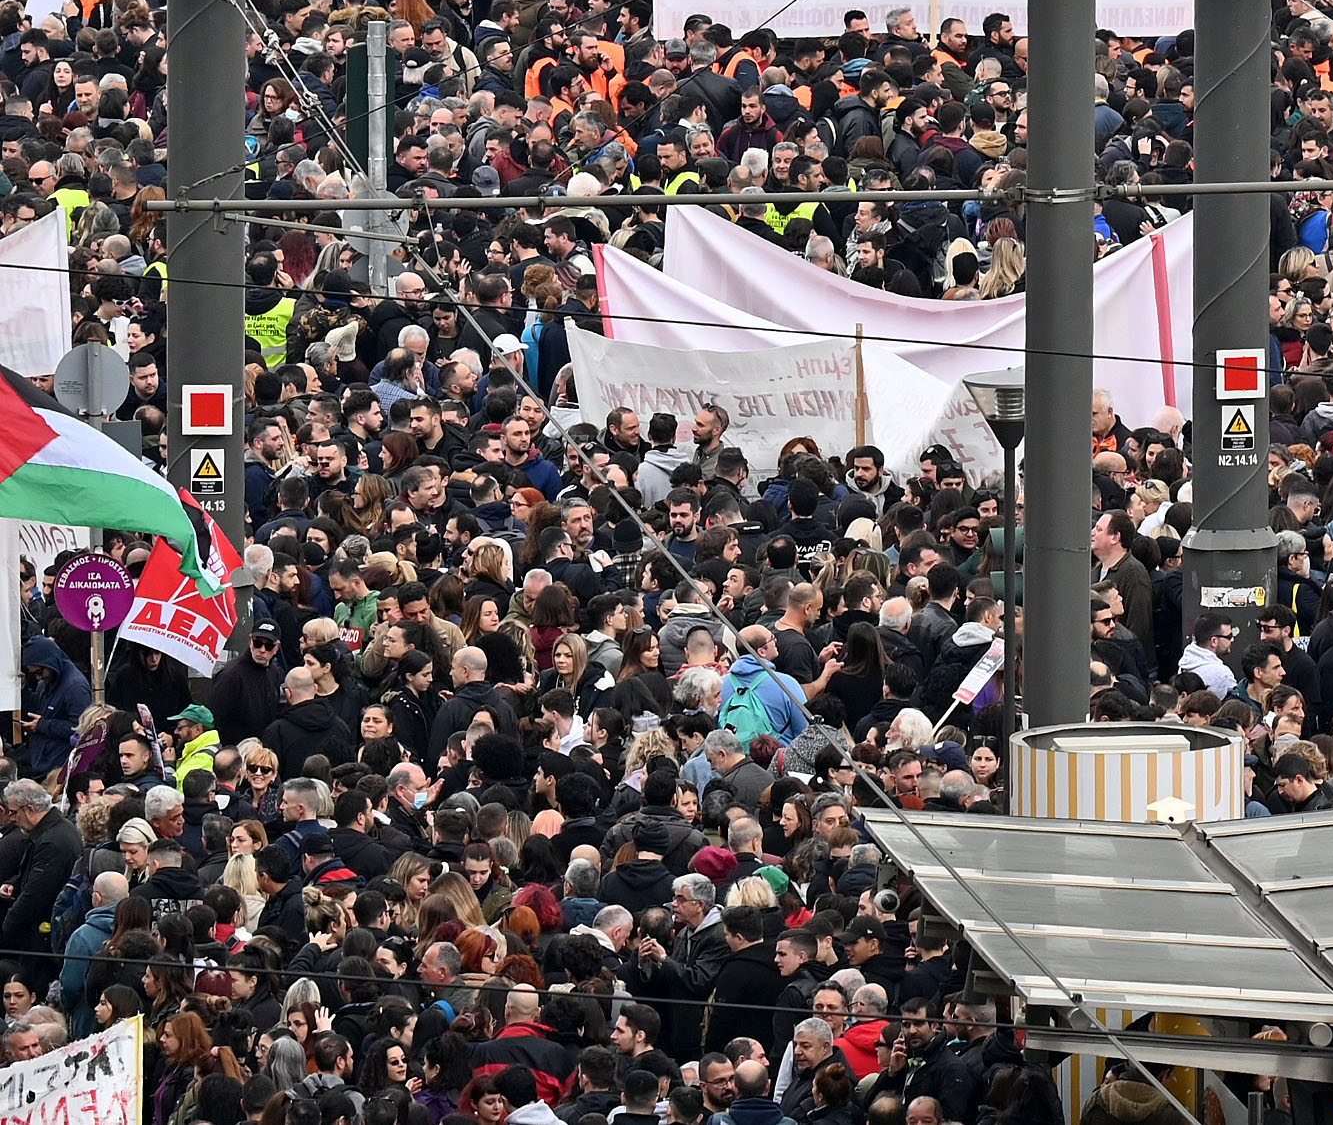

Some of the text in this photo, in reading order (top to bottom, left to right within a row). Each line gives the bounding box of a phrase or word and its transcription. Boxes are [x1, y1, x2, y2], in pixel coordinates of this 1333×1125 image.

[1218, 453, 1258, 467] N2.14.14
[57, 555, 132, 590] ΣΕΒΑΣΜΟΣ ΠΡΟΣΤΑΣΙΑ
[87, 572, 102, 581] ΙΣΑ
[69, 580, 121, 590] ΔΙΚΑΙΩΜΑΤΑ
[166, 632, 195, 649] ΕΡΓΑΤΙΚΗ
